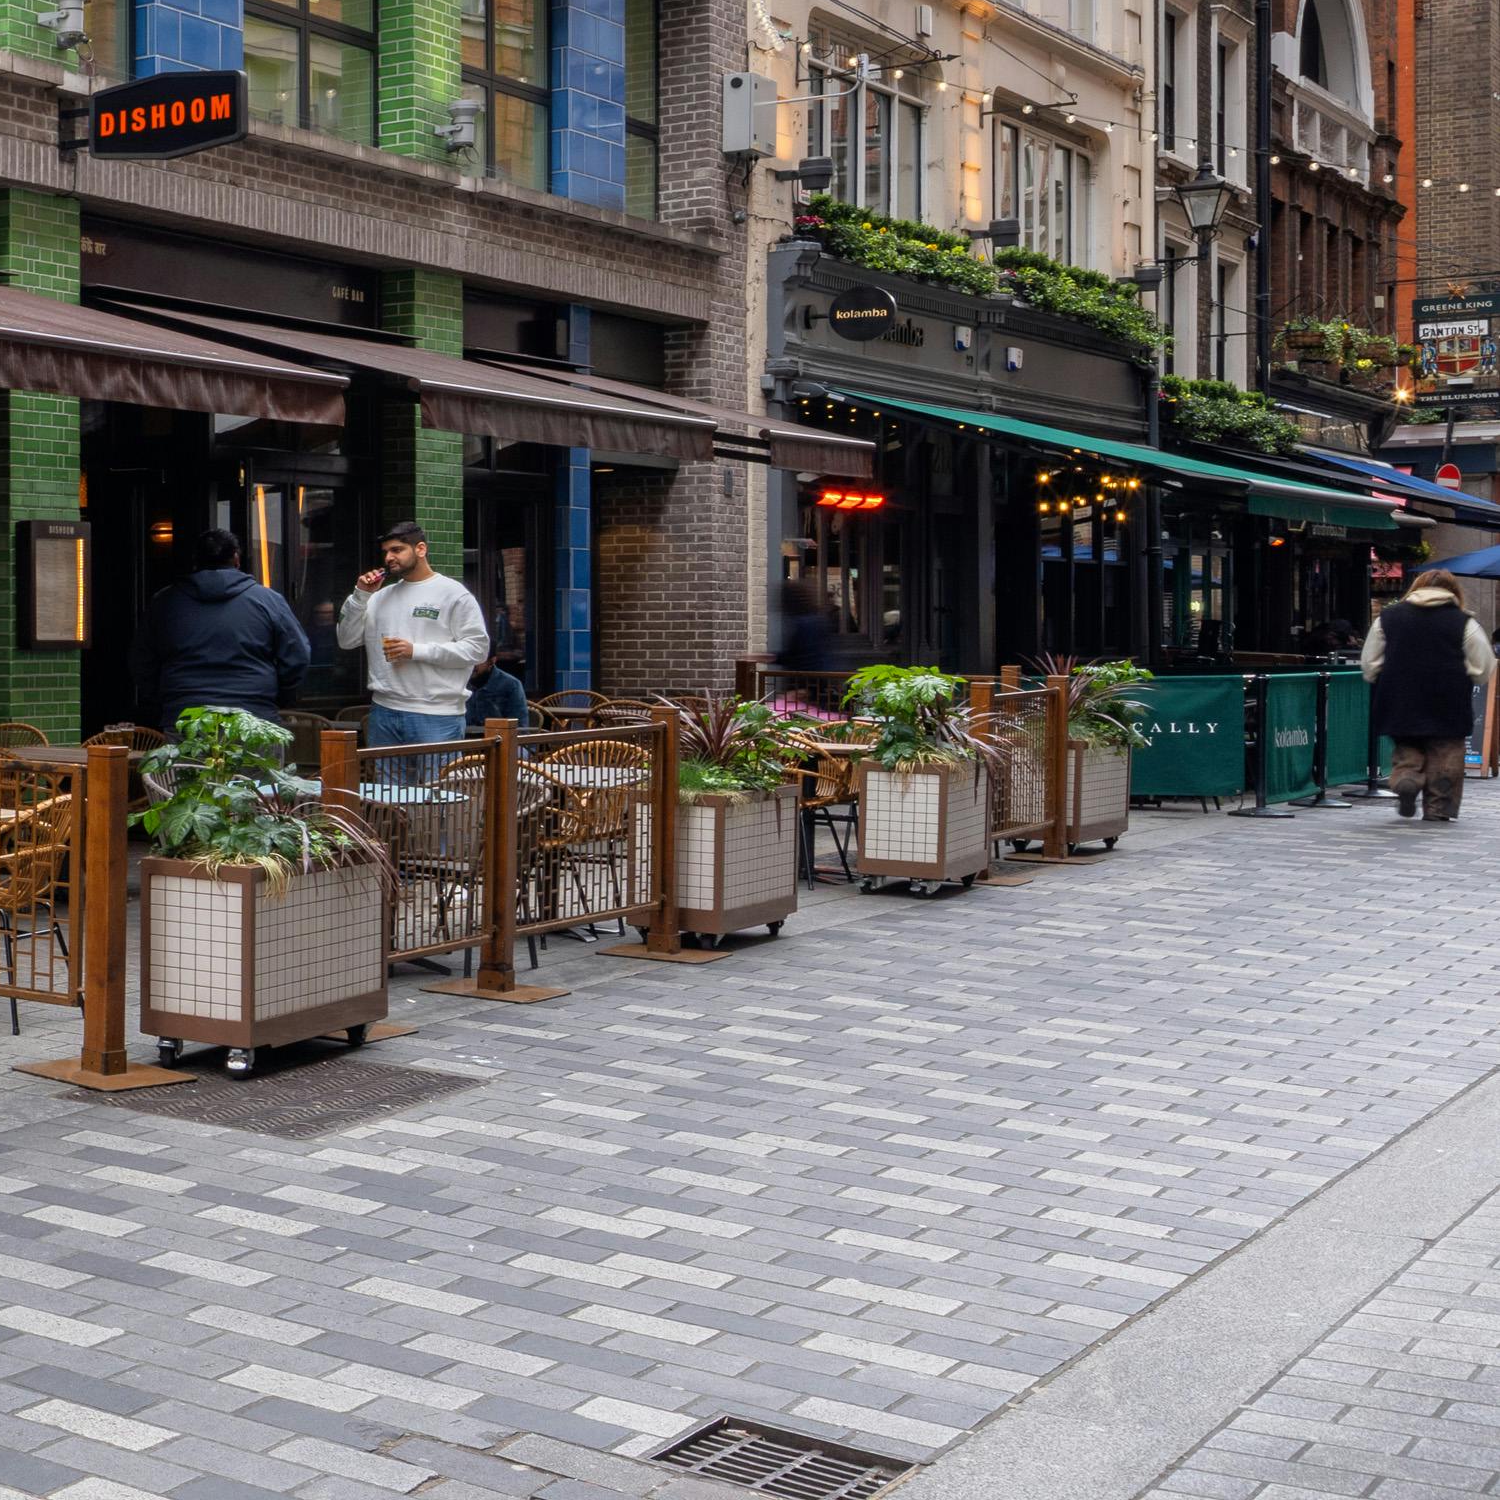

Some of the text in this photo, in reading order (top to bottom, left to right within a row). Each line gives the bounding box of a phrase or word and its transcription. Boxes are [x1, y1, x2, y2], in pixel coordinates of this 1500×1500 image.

[100, 93, 231, 137] DISHOOM
[1421, 302, 1462, 312] GREENE
[1465, 299, 1493, 309] KING
[836, 308, 888, 321] kolamba
[1469, 391, 1499, 400] POSTS
[48, 525, 75, 535] DISHOOM
[1274, 725, 1309, 748] kolamba
